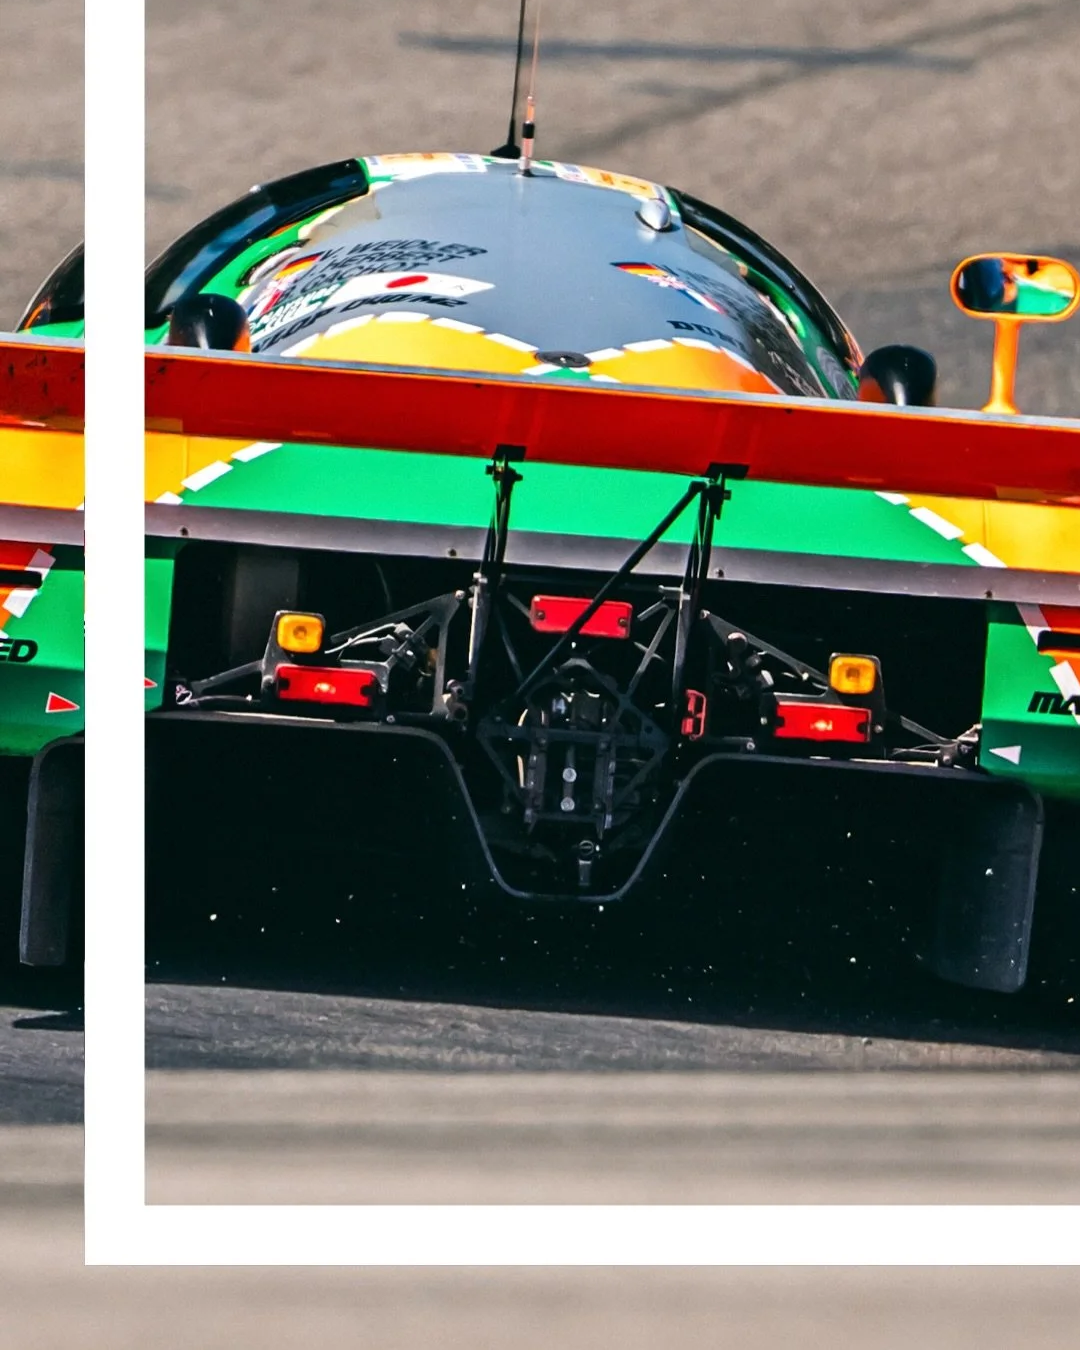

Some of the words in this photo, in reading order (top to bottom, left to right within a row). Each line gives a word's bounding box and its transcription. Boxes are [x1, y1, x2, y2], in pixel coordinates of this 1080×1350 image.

[347, 239, 488, 256] WEIDLER
[320, 251, 465, 273] HERBERT
[301, 262, 429, 293] GACHOT
